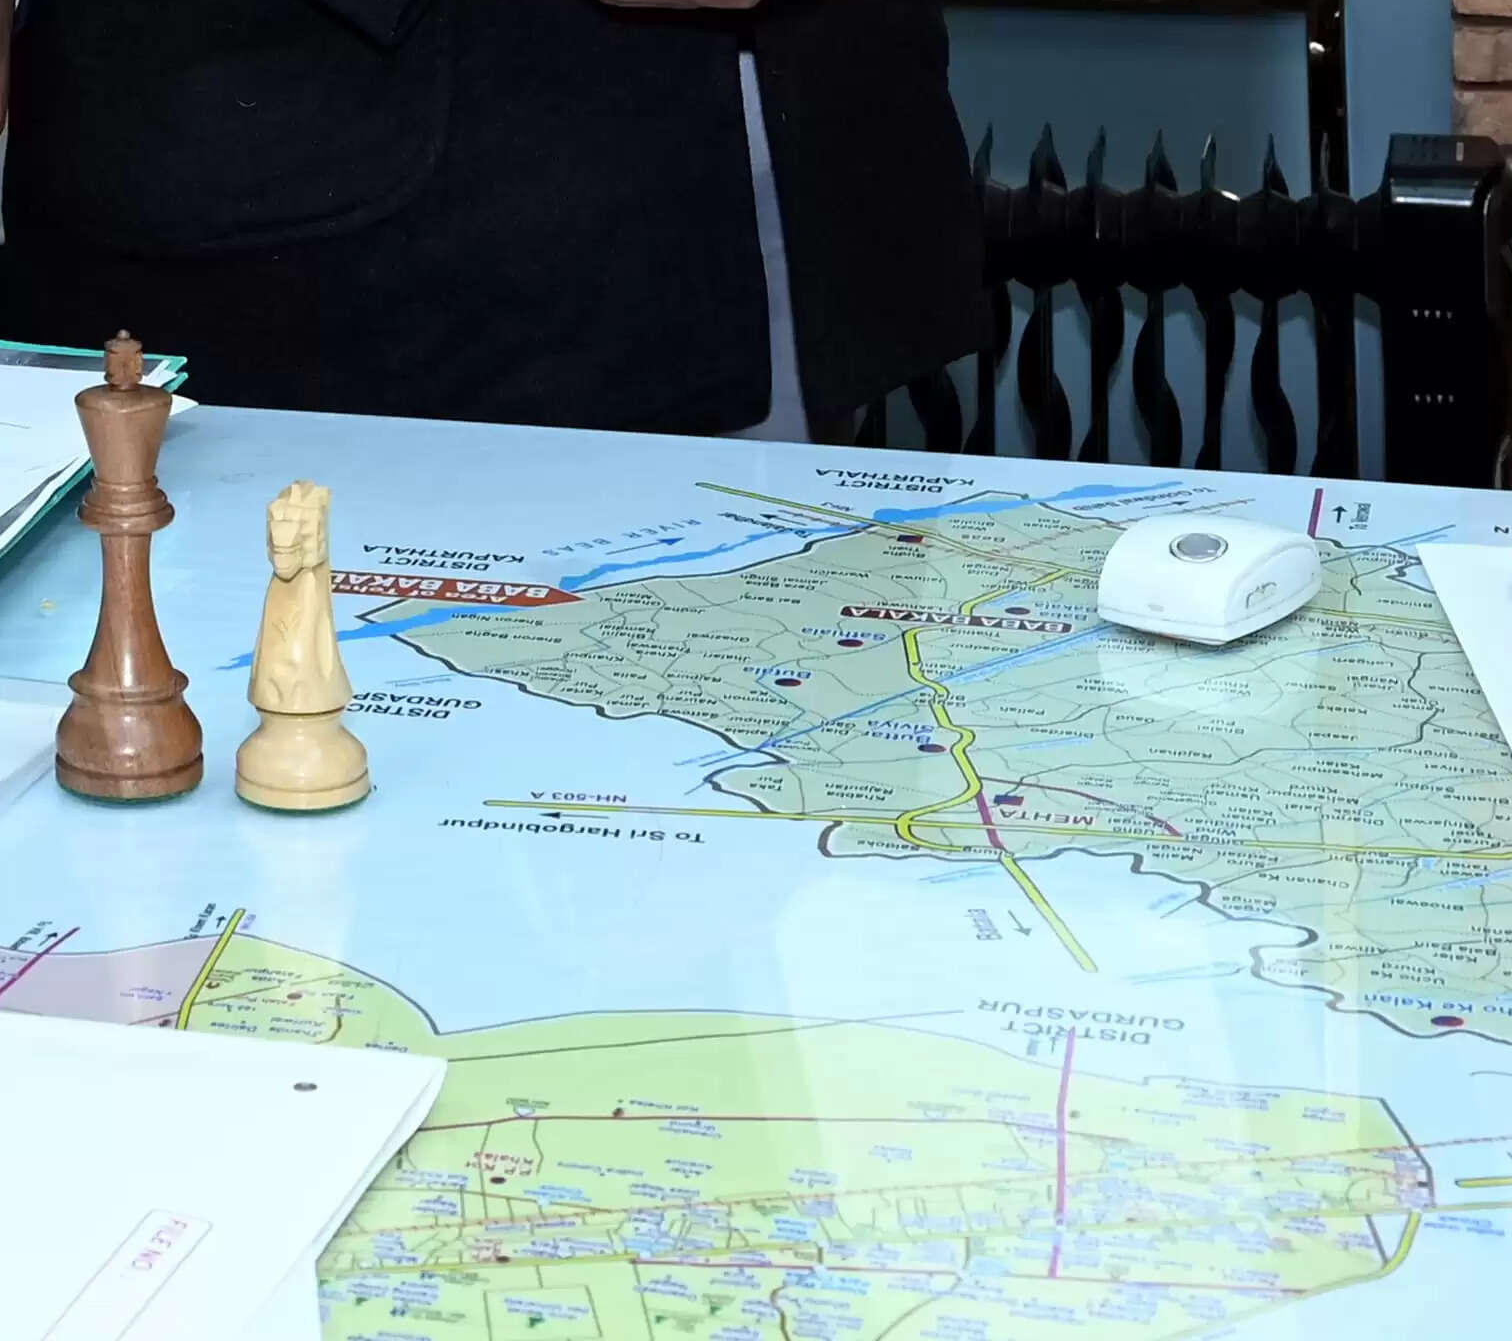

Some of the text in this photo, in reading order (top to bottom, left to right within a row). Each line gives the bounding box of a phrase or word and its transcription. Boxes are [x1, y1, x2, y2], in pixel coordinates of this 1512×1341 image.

[815, 469, 974, 486] KAPURTHALA
[832, 480, 943, 493] DISTRICT
[363, 544, 525, 564] KAPURTHALA
[378, 556, 490, 572] DISTRICT
[456, 581, 550, 597] BABA
[849, 607, 1063, 633] BABA BAKALA
[742, 666, 812, 679] Butala
[351, 691, 482, 710] GURDASP
[344, 702, 450, 719] DISTRIC
[999, 808, 1094, 826] MEHTA
[437, 818, 705, 844] To Sri Hargobindpur
[1364, 994, 1432, 1012] Kalan
[1443, 1002, 1473, 1013] Ke
[979, 997, 1185, 1031] GURDASPUR
[1001, 1021, 1151, 1045] DISTRICT
